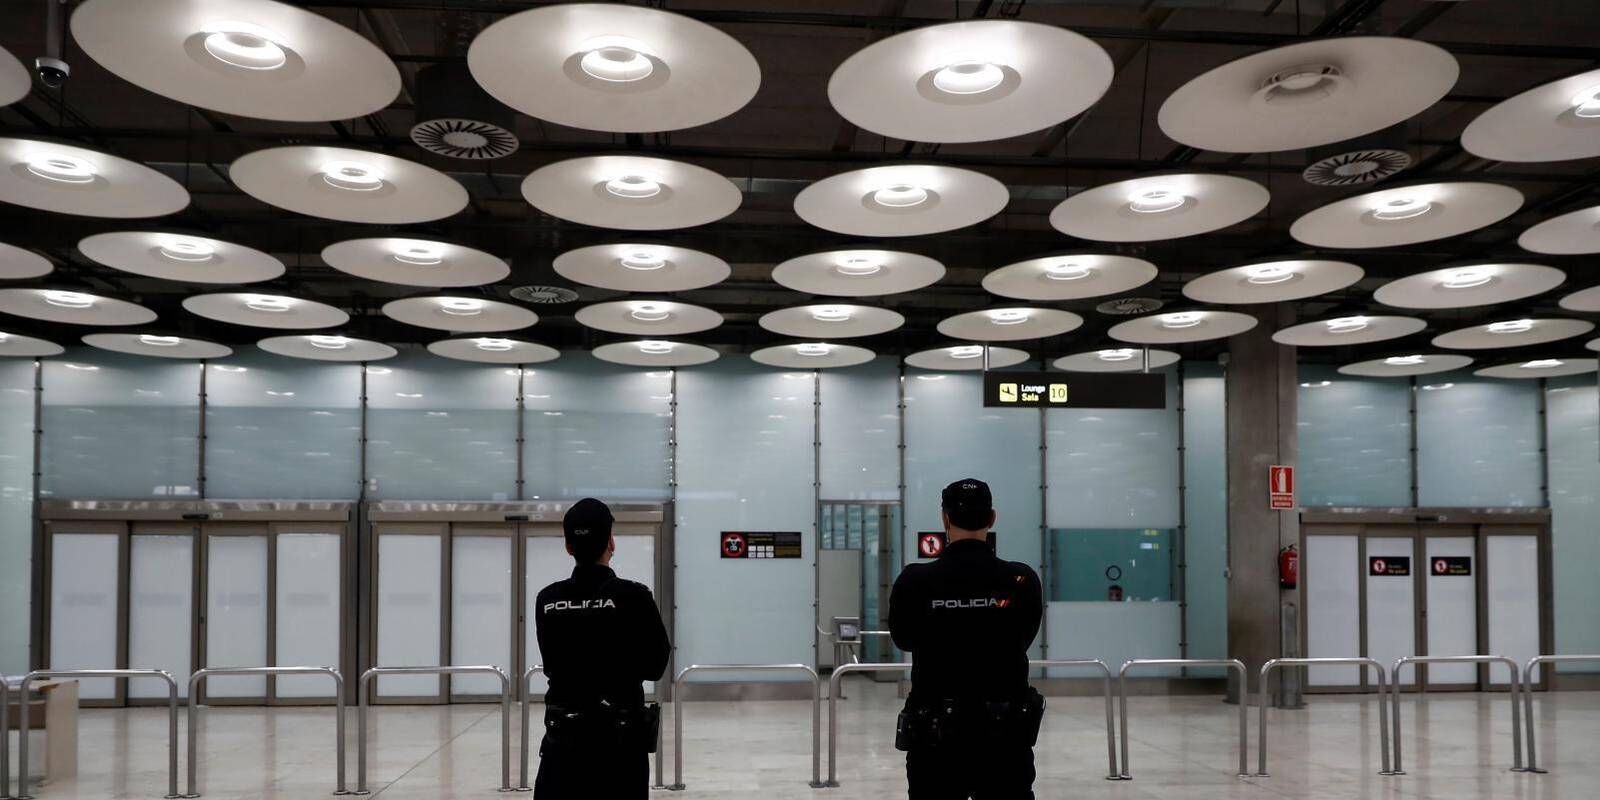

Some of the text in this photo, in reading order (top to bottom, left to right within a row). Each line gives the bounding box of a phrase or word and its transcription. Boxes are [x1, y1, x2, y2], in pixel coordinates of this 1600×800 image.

[1021, 384, 1045, 393] Lounge
[1052, 388, 1066, 398] 10
[1022, 393, 1039, 401] Sala
[544, 599, 616, 614] POLICIA
[932, 598, 998, 608] POLICIA
